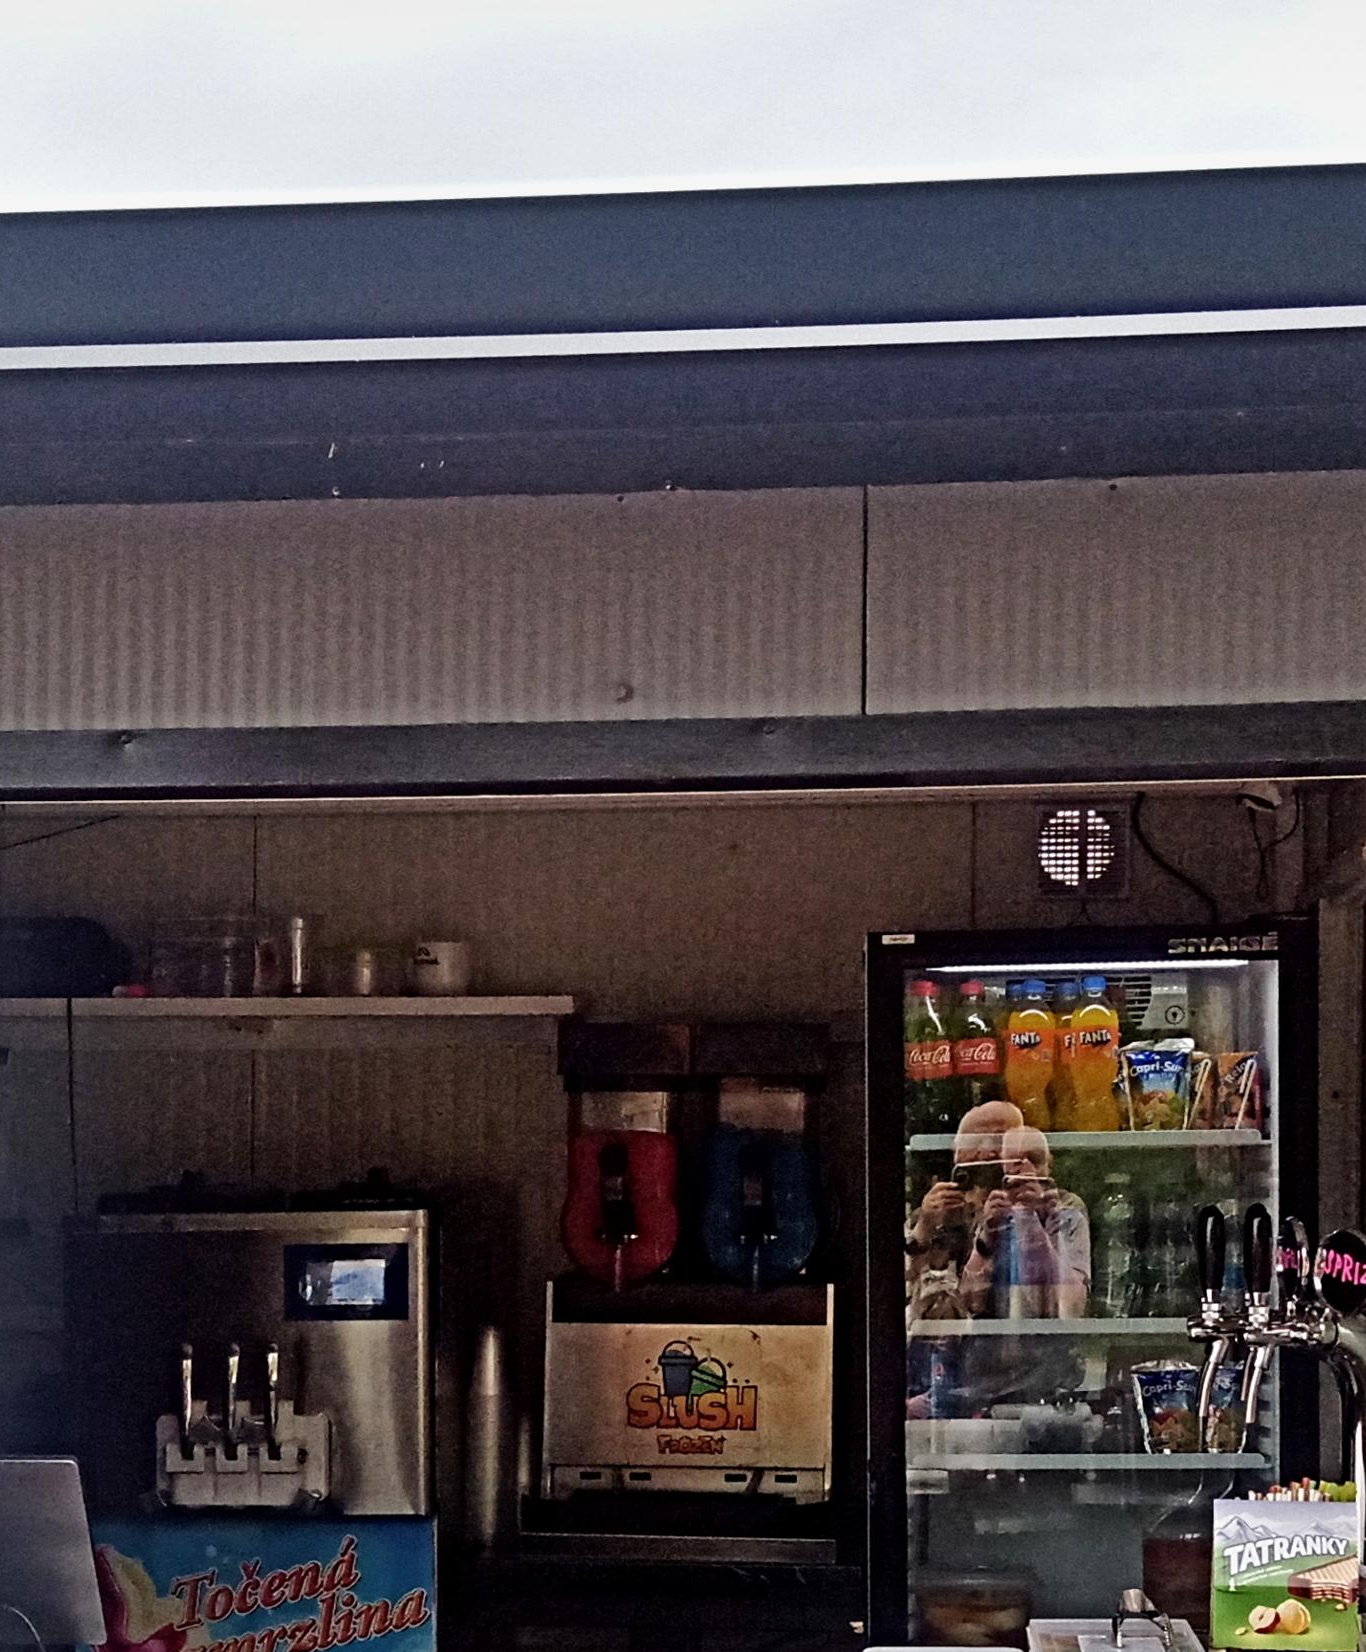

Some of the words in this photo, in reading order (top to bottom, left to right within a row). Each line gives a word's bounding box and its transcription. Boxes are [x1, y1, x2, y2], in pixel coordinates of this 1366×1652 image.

[625, 1382, 758, 1431] SLUSH
[1223, 1534, 1349, 1577] TATRANKY
[171, 1534, 362, 1631] Točená
